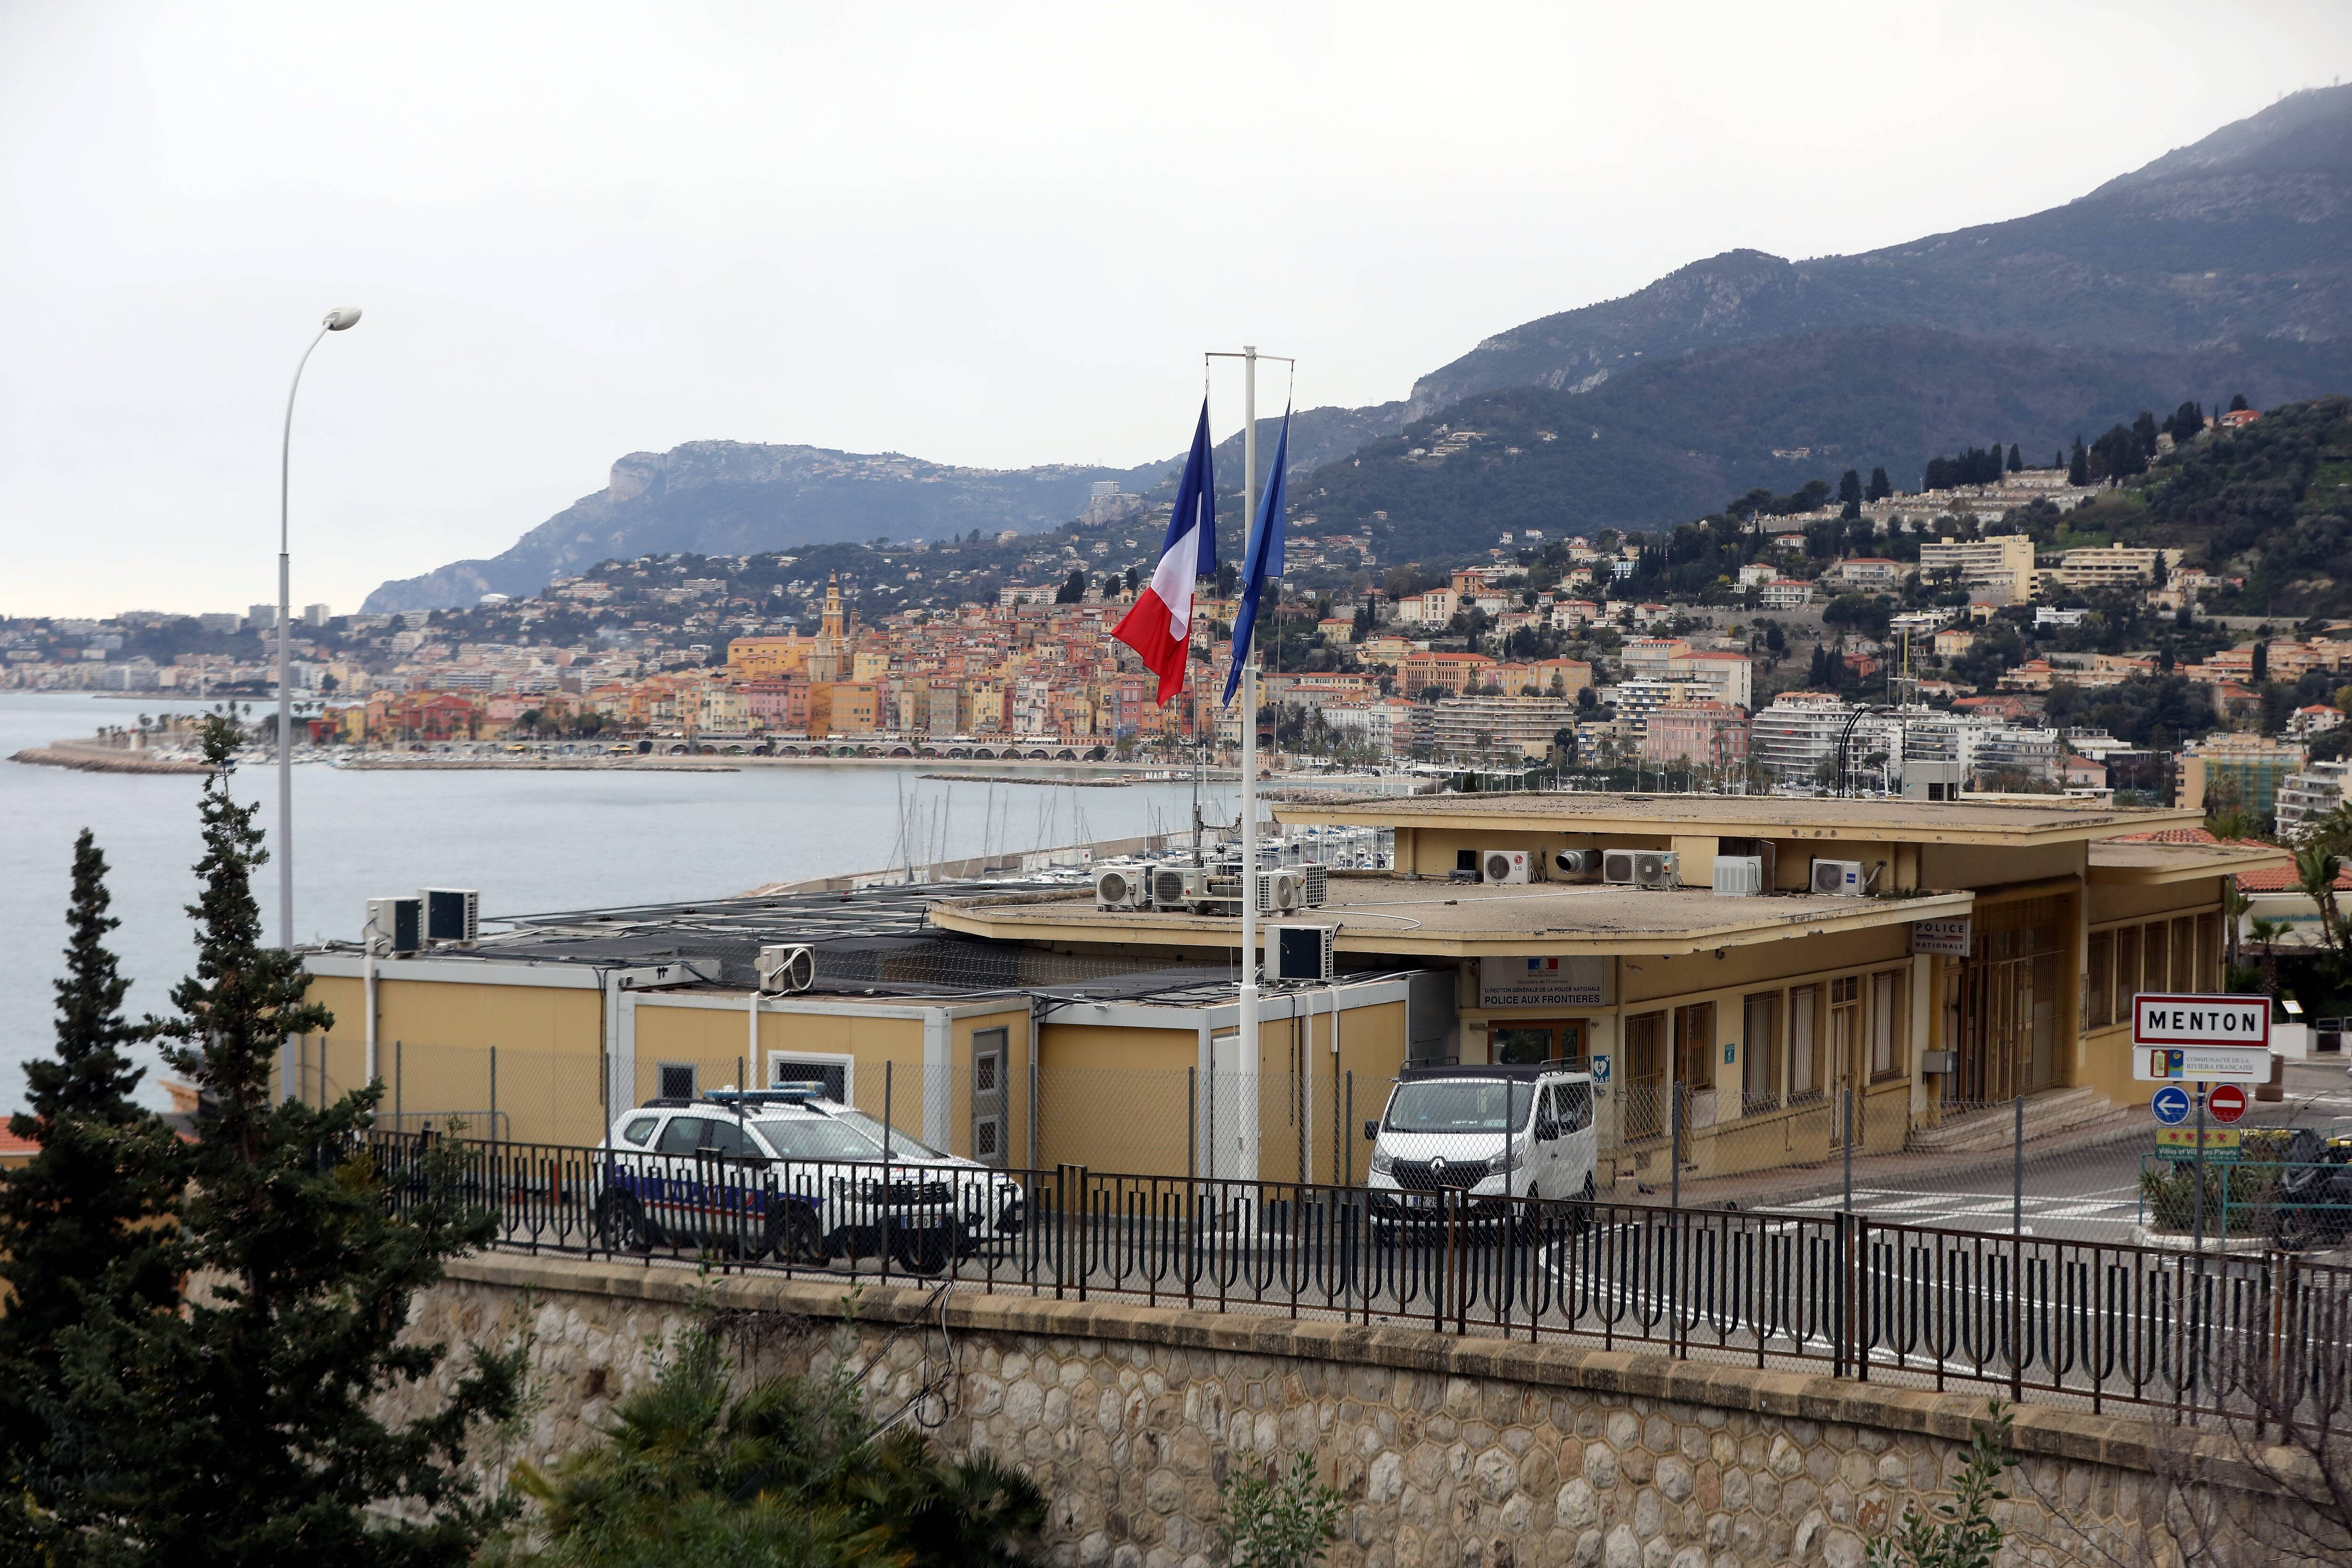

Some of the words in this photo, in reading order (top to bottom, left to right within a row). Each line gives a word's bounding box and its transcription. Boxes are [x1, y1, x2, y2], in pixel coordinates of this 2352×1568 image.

[1915, 923, 1964, 933] POLICE
[1485, 996, 1518, 1004] POLICE
[1542, 995, 1600, 1003] FRONTIERES
[2148, 1011, 2256, 1031] MENTON
